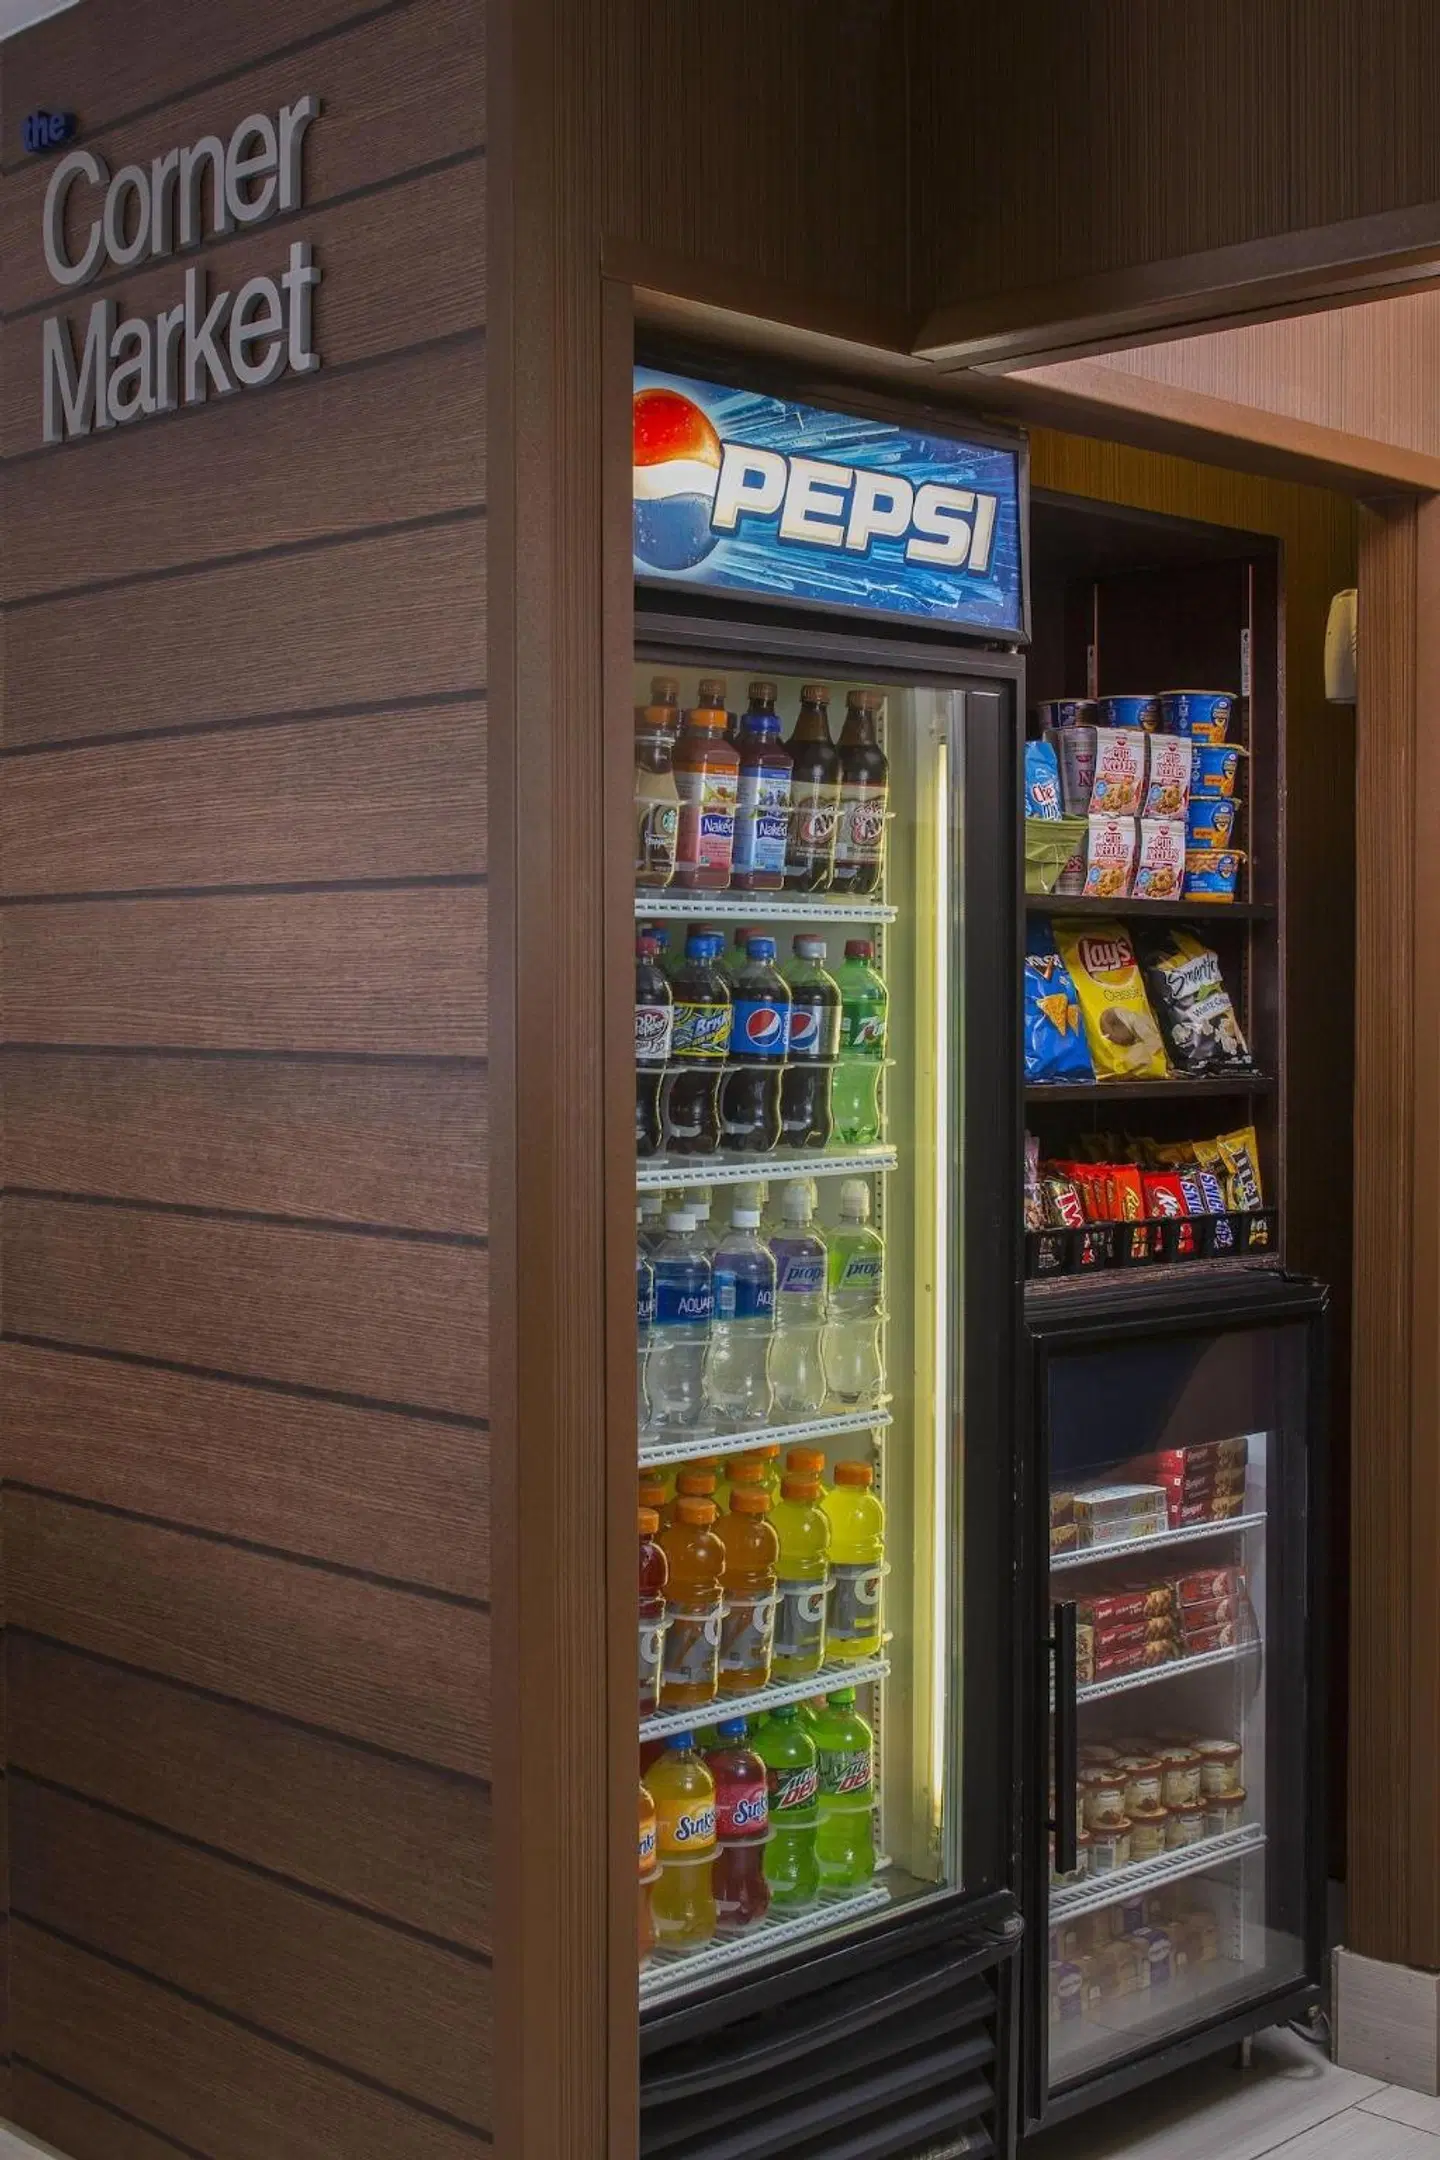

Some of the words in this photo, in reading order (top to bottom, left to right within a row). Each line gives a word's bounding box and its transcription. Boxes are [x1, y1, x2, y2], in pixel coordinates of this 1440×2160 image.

[23, 111, 70, 153] the
[43, 95, 320, 285] Corner
[43, 240, 321, 442] Market
[711, 443, 997, 572] PEPSI
[703, 817, 734, 834] Naked
[759, 820, 788, 838] Naked
[1083, 939, 1132, 973] Lay's
